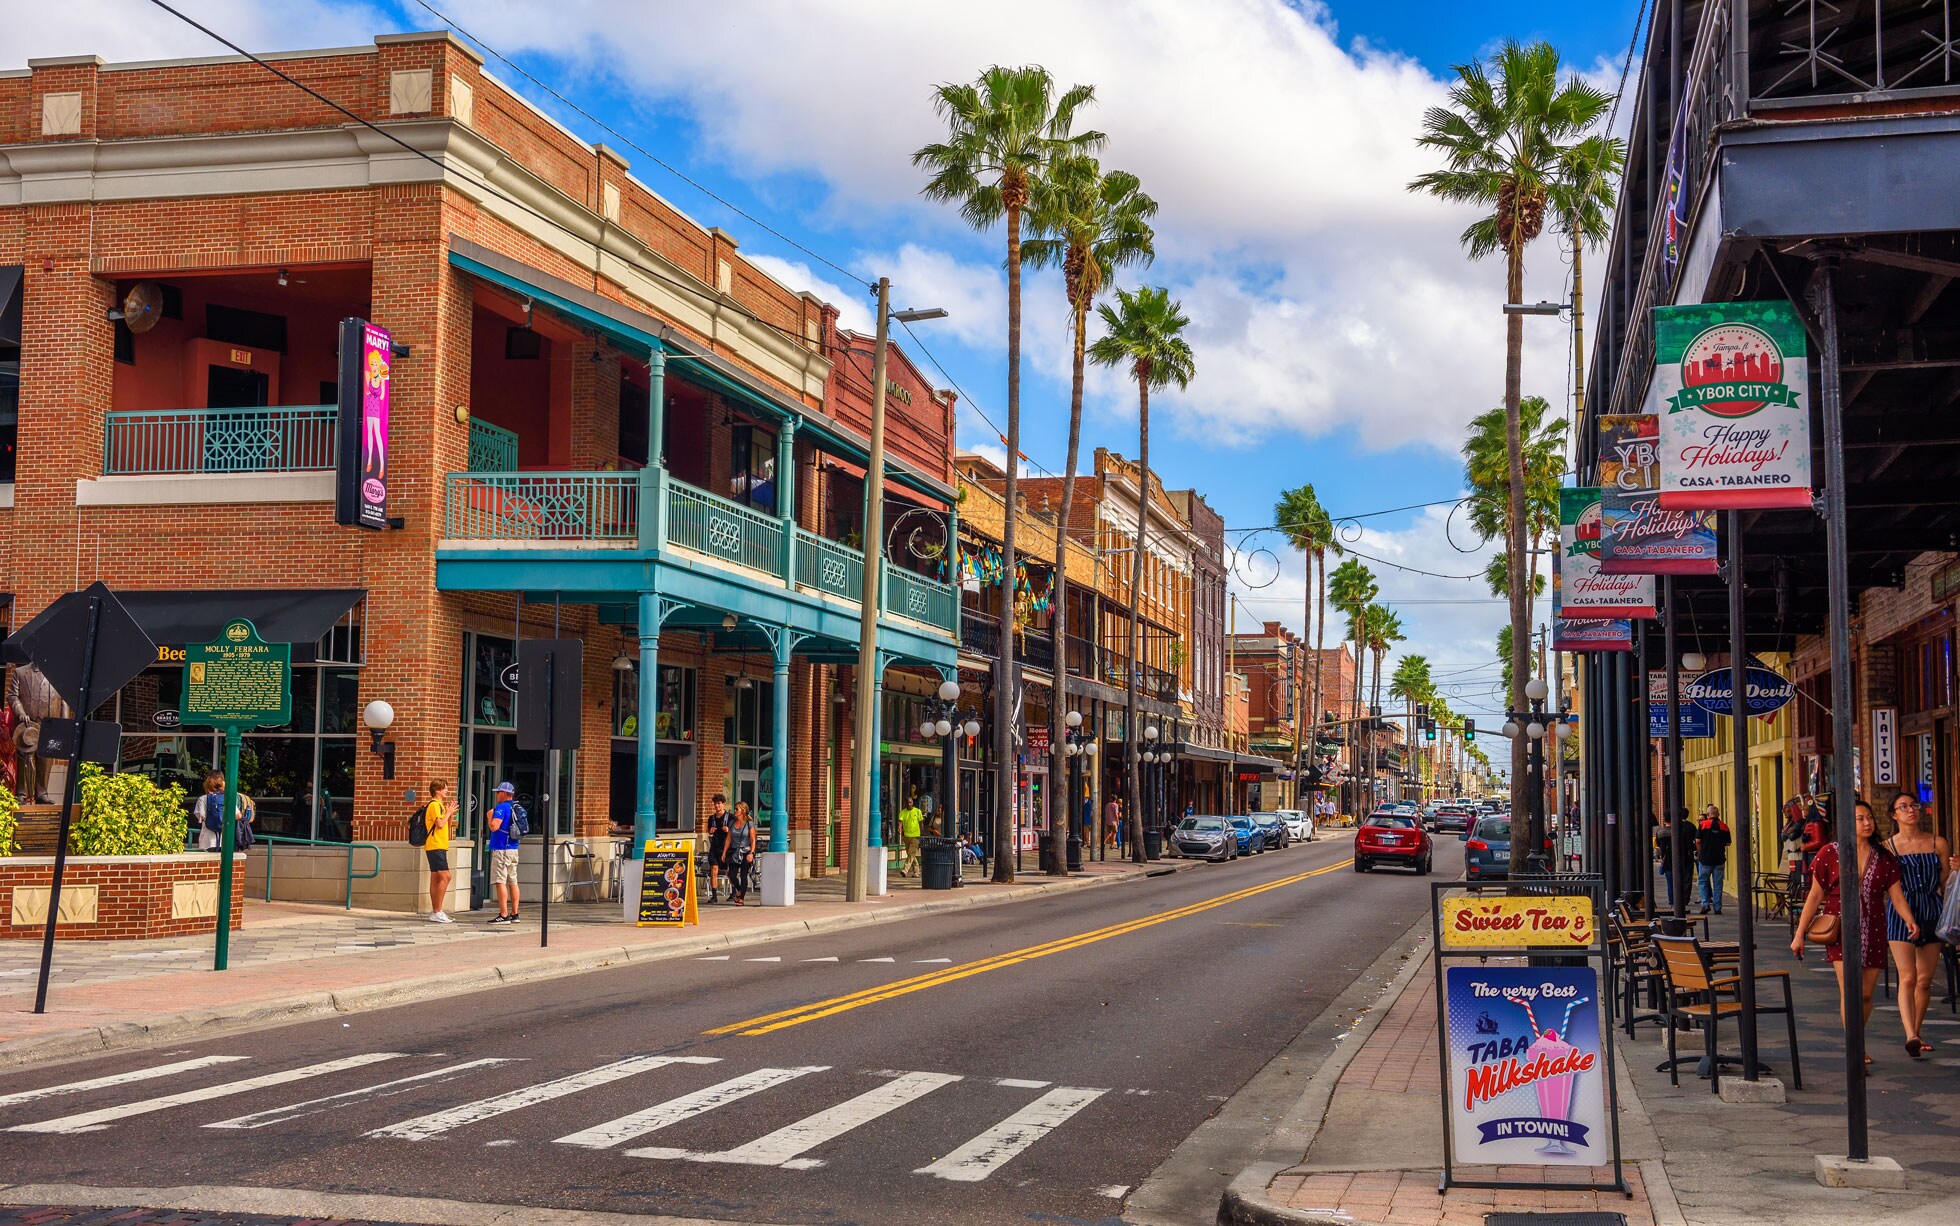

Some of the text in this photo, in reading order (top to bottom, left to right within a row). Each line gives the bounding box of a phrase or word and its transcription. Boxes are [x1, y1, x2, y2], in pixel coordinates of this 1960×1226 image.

[366, 333, 389, 351] MARY!
[1713, 342, 1740, 353] Tampa,
[236, 350, 249, 364] EXIT
[1697, 385, 1772, 400] YBOR CITY
[1703, 423, 1772, 450] Happy
[1680, 439, 1790, 471] Holidays!
[1680, 473, 1791, 488] CASA TABANERO
[1612, 510, 1704, 541] Holidays!
[1614, 545, 1704, 555] CASA TABANERO
[1573, 576, 1642, 596] Holidays!
[1599, 597, 1644, 605] TABANERO
[1689, 685, 1733, 699] Blue
[1745, 683, 1794, 698] Devil
[1880, 711, 1891, 781] TATTOO
[1455, 908, 1585, 931] Sweet Tea &
[1470, 982, 1577, 1000] The very Best
[1467, 1039, 1528, 1064] TABA
[1465, 1048, 1596, 1111] Milkshake
[1497, 1121, 1569, 1137] IN TOWN!
